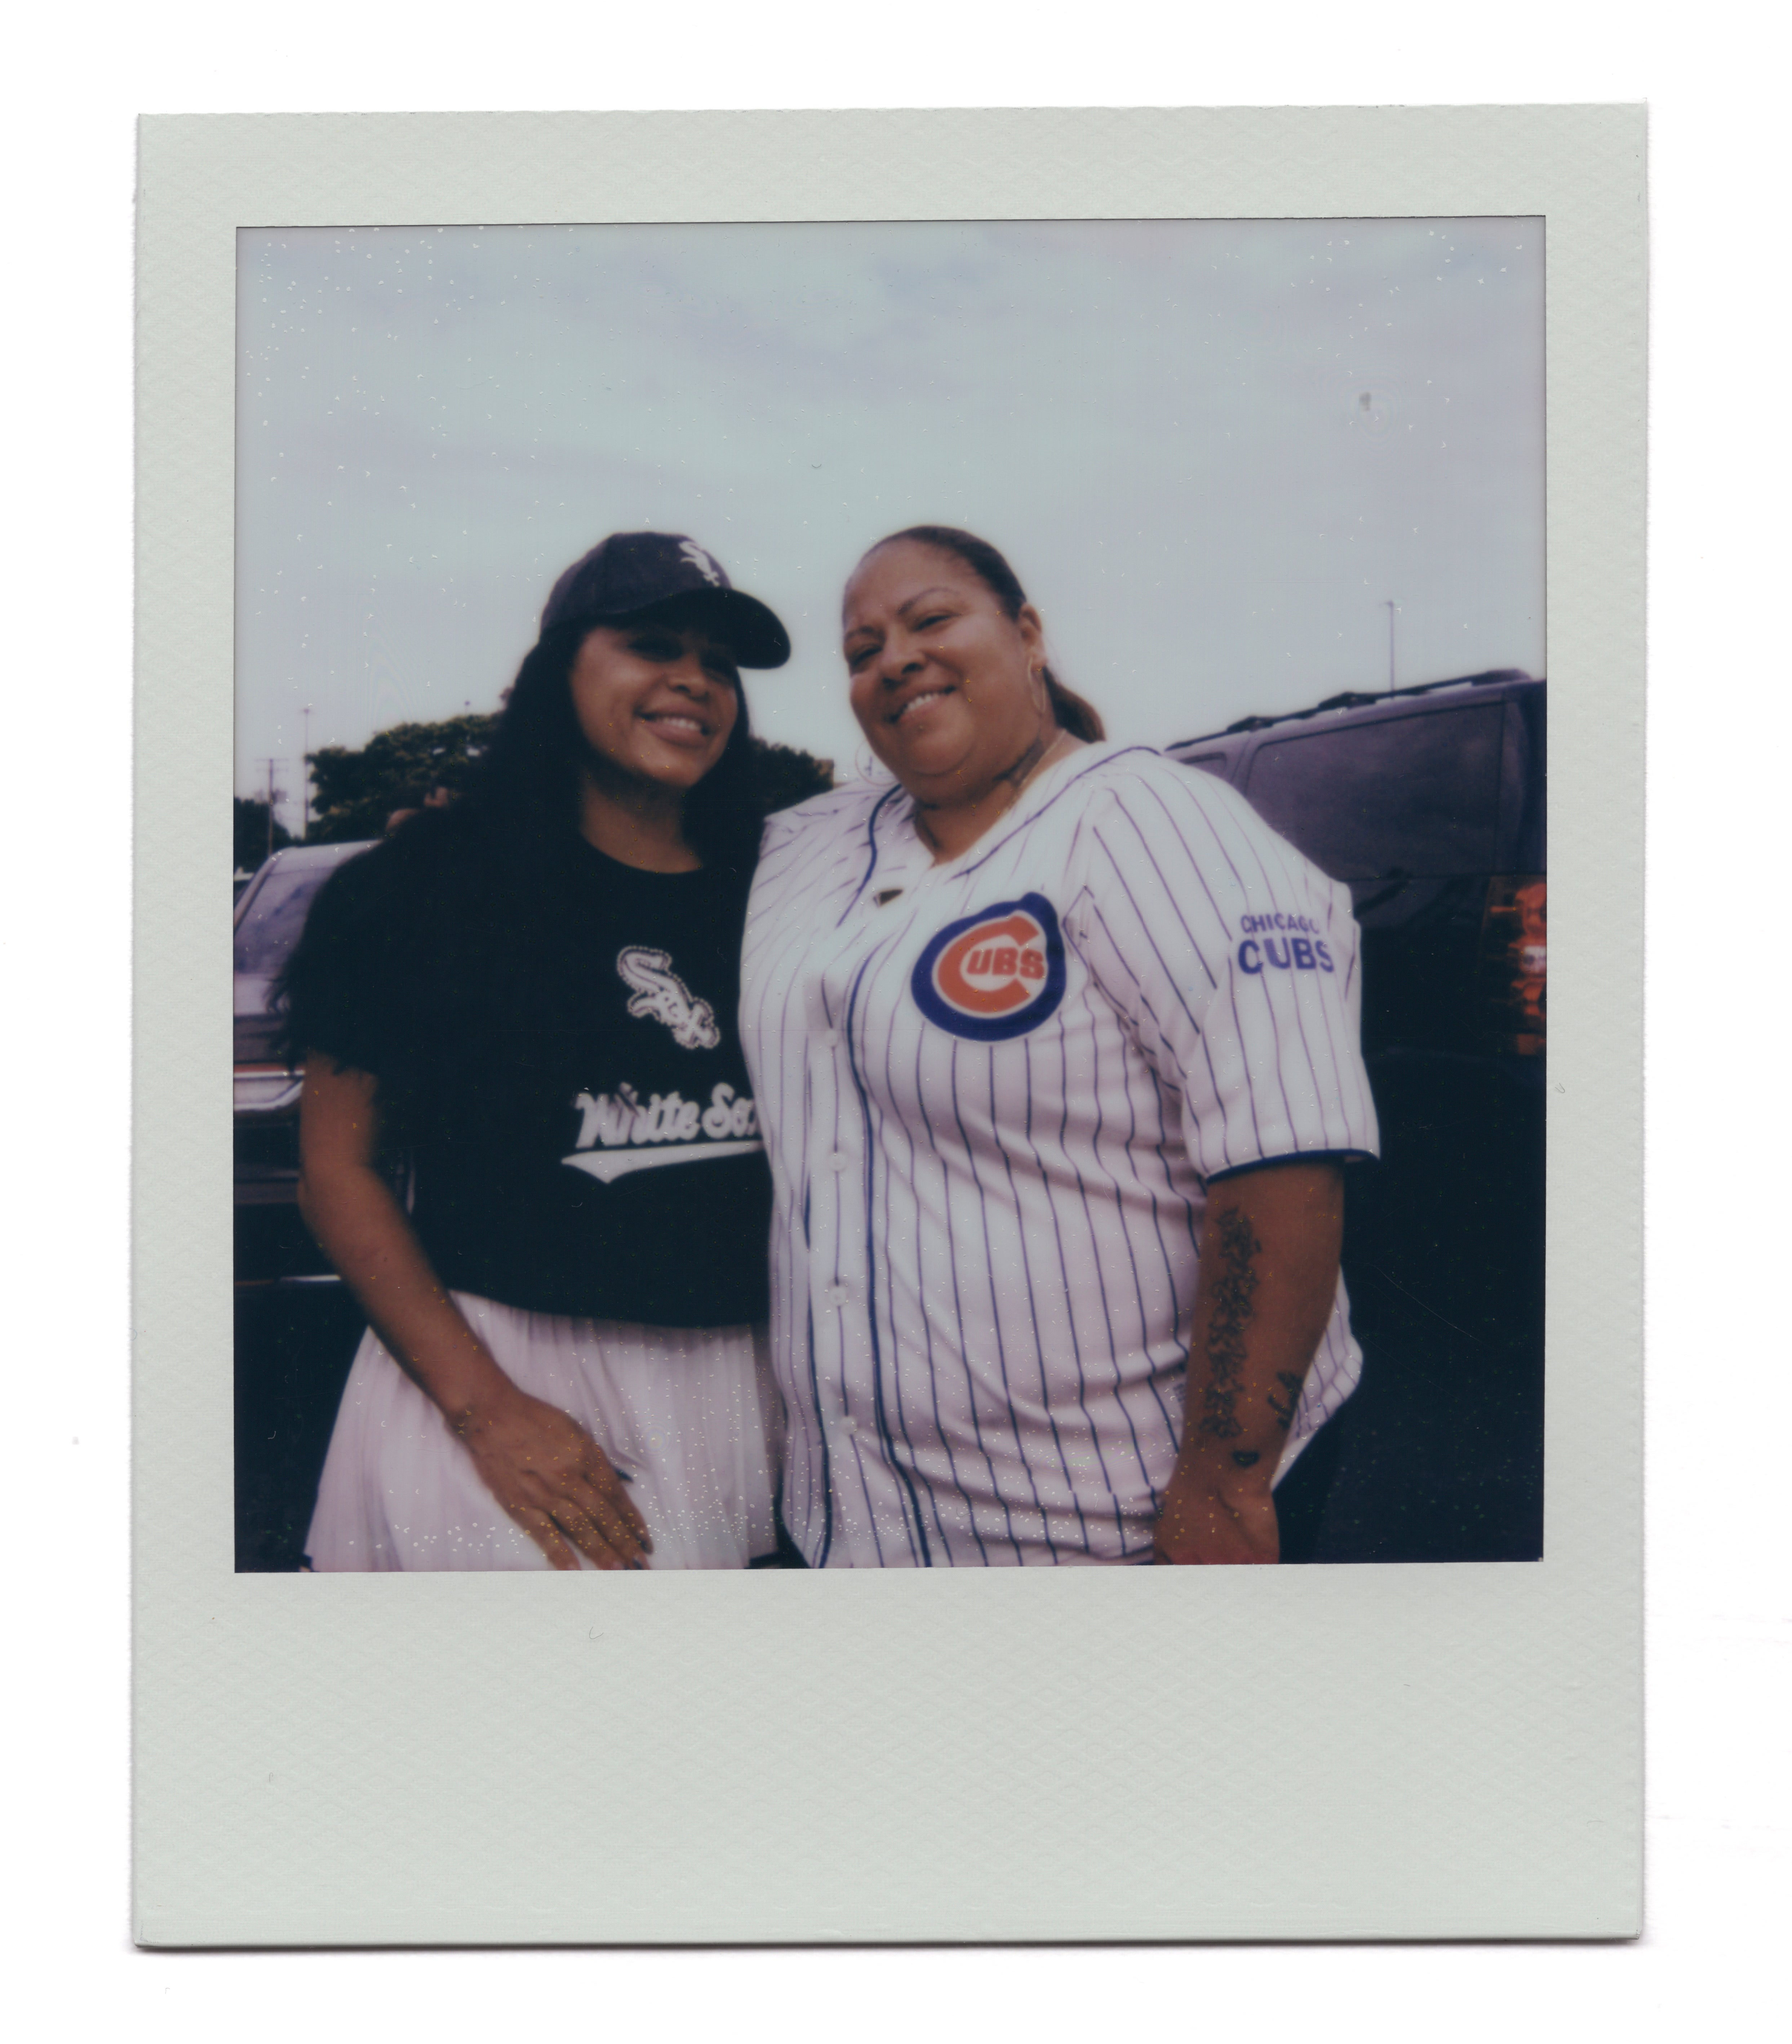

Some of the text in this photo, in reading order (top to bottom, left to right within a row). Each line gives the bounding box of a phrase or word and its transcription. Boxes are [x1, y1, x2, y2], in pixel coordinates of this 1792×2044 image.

[938, 915, 1044, 1013] CUBS
[1238, 937, 1334, 974] CUBS
[575, 1081, 700, 1148] White
